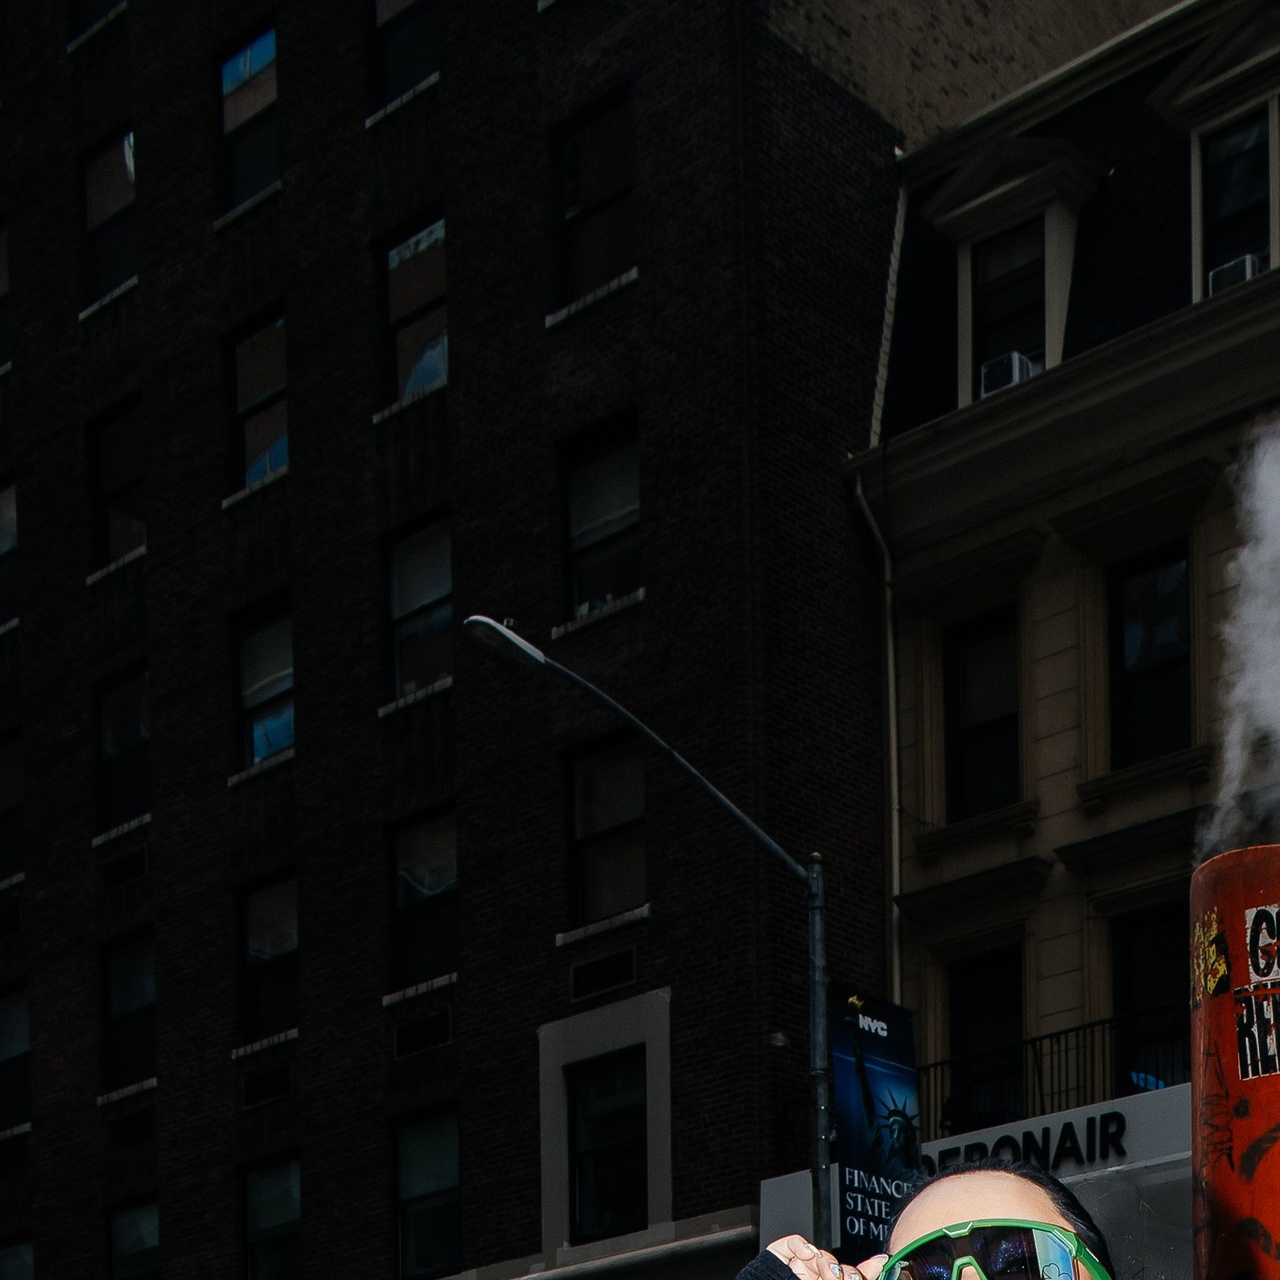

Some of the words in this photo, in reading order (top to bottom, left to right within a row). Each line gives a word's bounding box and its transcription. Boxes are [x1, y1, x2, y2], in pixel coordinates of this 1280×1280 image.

[858, 1013, 888, 1037] NYC
[845, 1191, 891, 1219] STATE
[846, 1216, 867, 1236] OF
